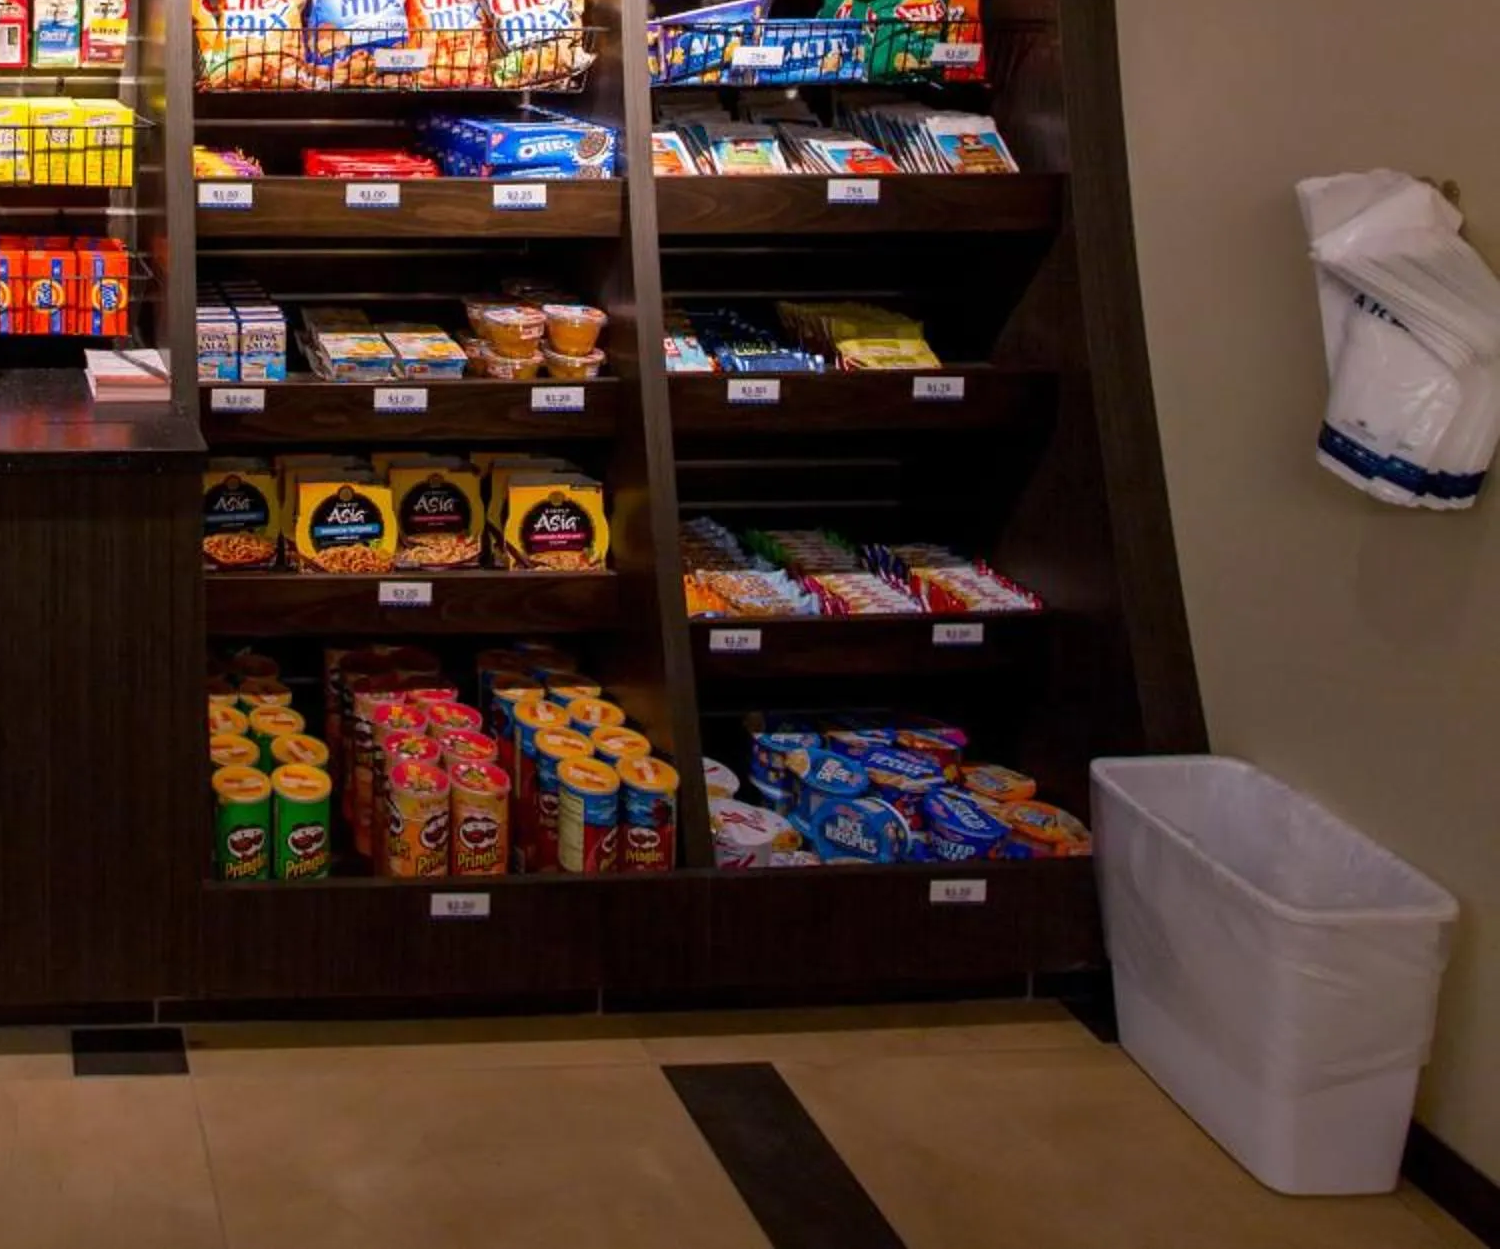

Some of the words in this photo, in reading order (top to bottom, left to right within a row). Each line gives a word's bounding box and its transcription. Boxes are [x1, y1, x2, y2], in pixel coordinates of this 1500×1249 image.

[225, 5, 289, 39] mix
[430, 3, 482, 32] mix
[504, 3, 570, 43] mix
[213, 496, 252, 512] Asia
[413, 494, 456, 513] Asia
[327, 508, 366, 524] Asia
[533, 513, 577, 532] Asia
